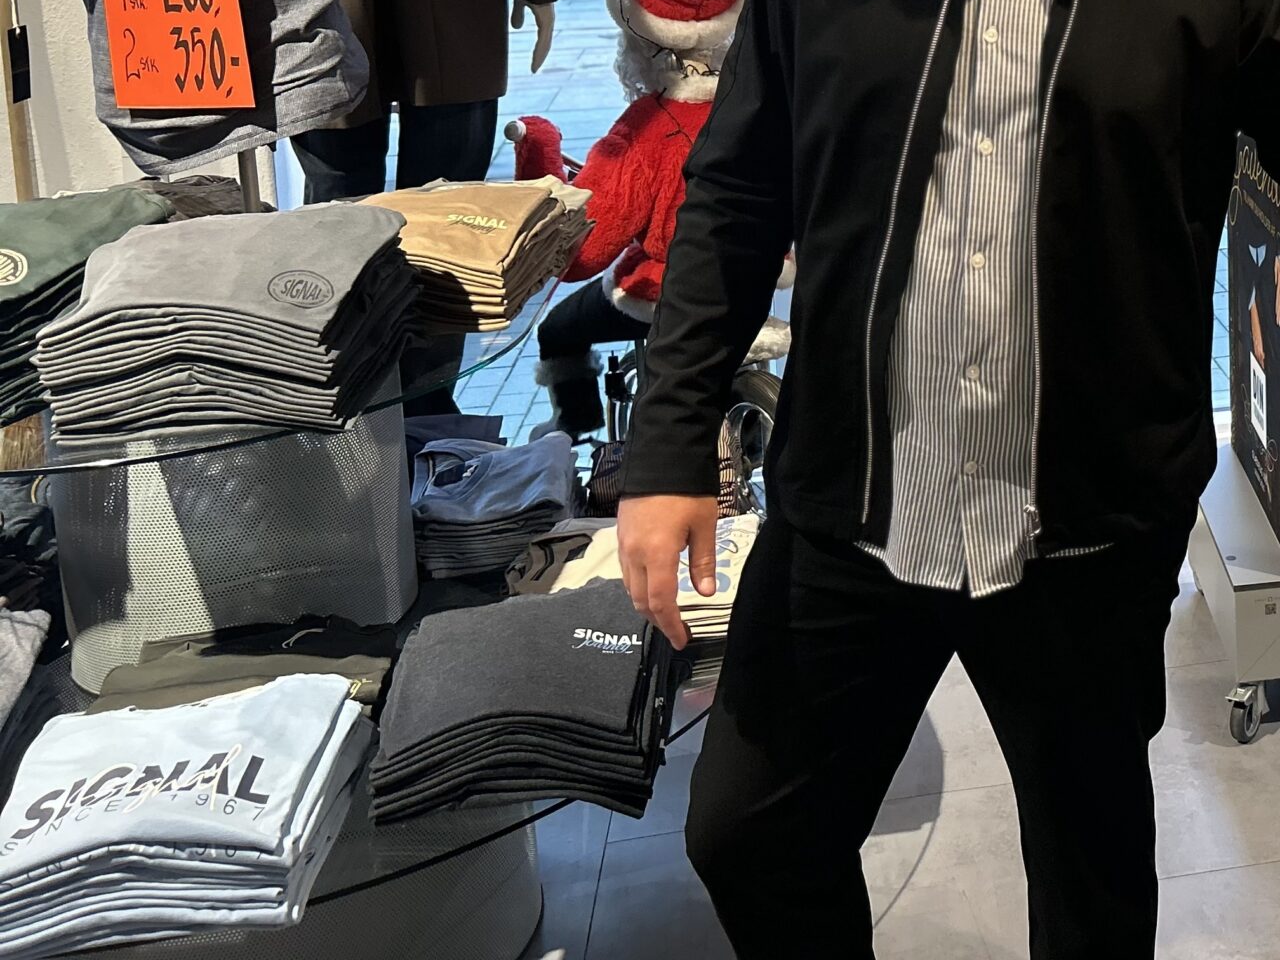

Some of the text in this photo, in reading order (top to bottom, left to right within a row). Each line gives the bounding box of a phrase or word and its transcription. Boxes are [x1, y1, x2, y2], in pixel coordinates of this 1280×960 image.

[123, 28, 141, 82] 2
[447, 214, 508, 229] SIGNAL
[281, 278, 322, 301] SIGNAL
[573, 628, 643, 645] SIGNAL
[10, 751, 270, 840] SIGNAL
[170, 793, 267, 821] 1967
